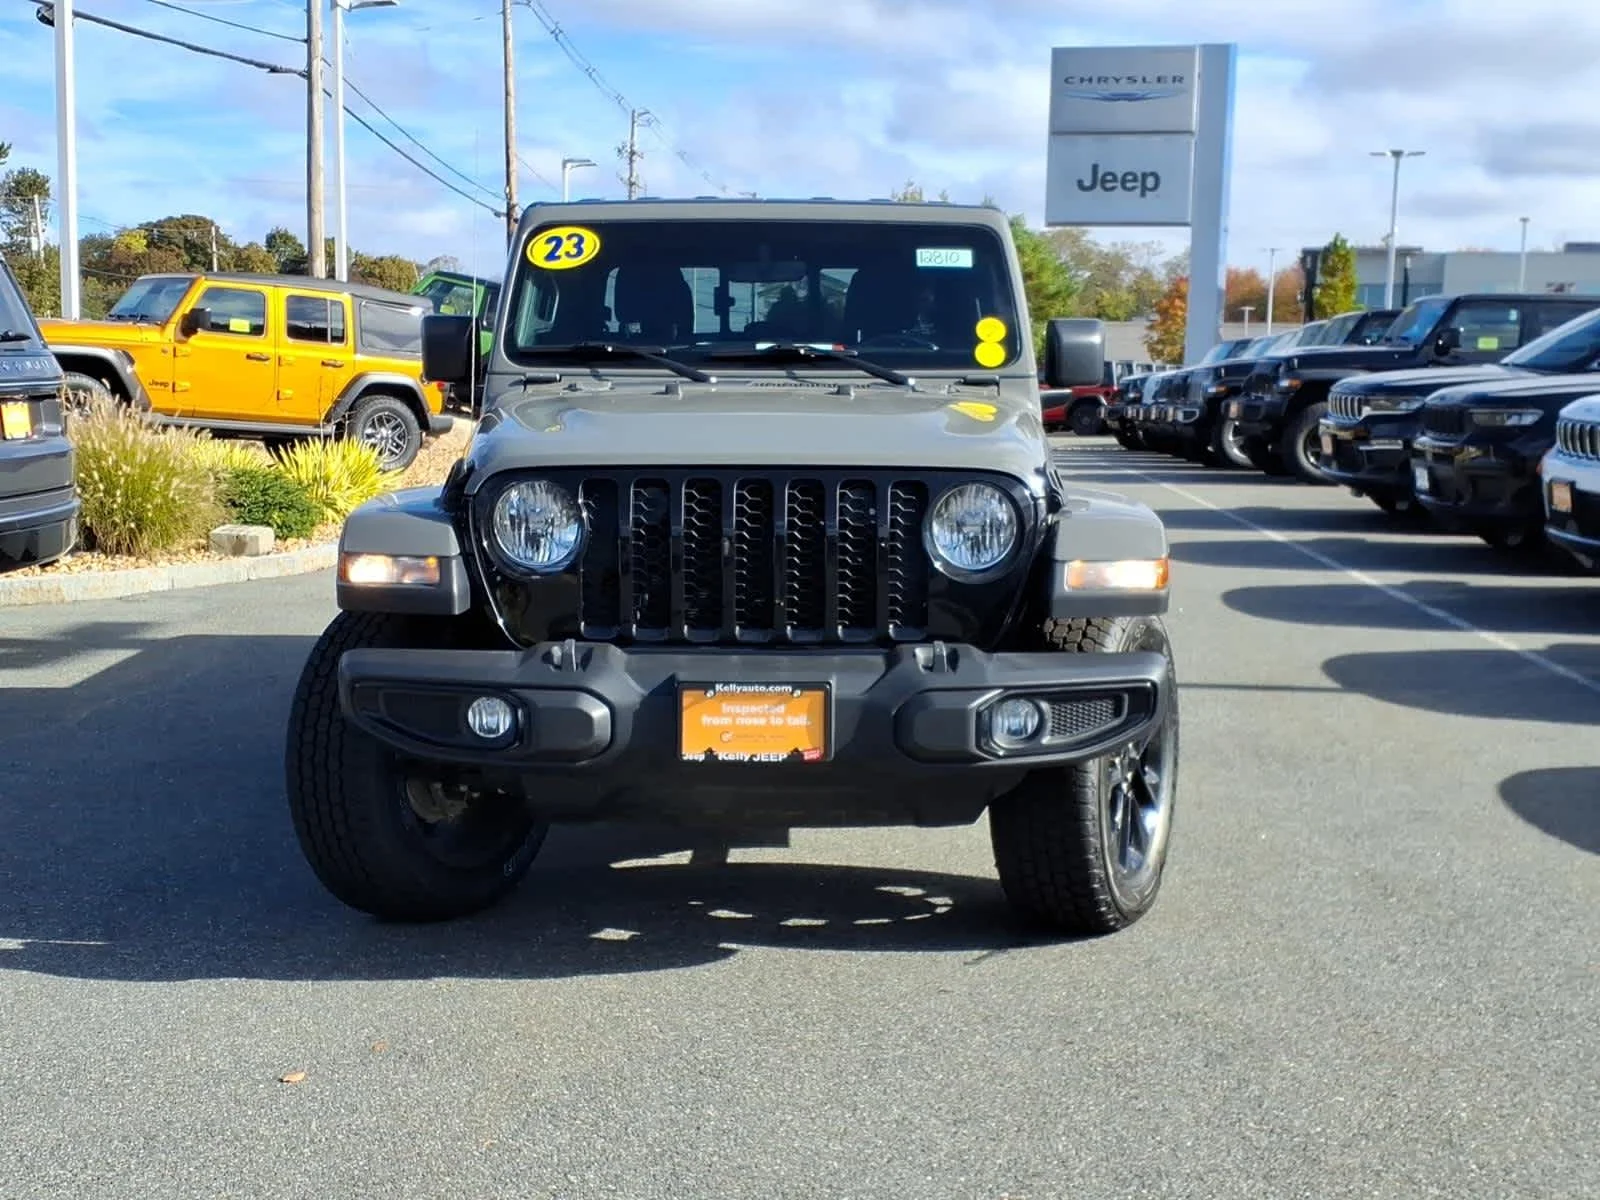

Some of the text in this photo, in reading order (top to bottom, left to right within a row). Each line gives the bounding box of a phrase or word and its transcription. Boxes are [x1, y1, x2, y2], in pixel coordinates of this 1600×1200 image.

[1063, 75, 1184, 85] CHRYSLER
[1076, 163, 1161, 198] Jeep
[544, 233, 585, 262] 23
[715, 683, 792, 694] Kellyauto.com
[721, 704, 786, 715] Inspected
[702, 715, 733, 726] from
[771, 715, 784, 726] to
[718, 752, 788, 762] Kelly JEEP
